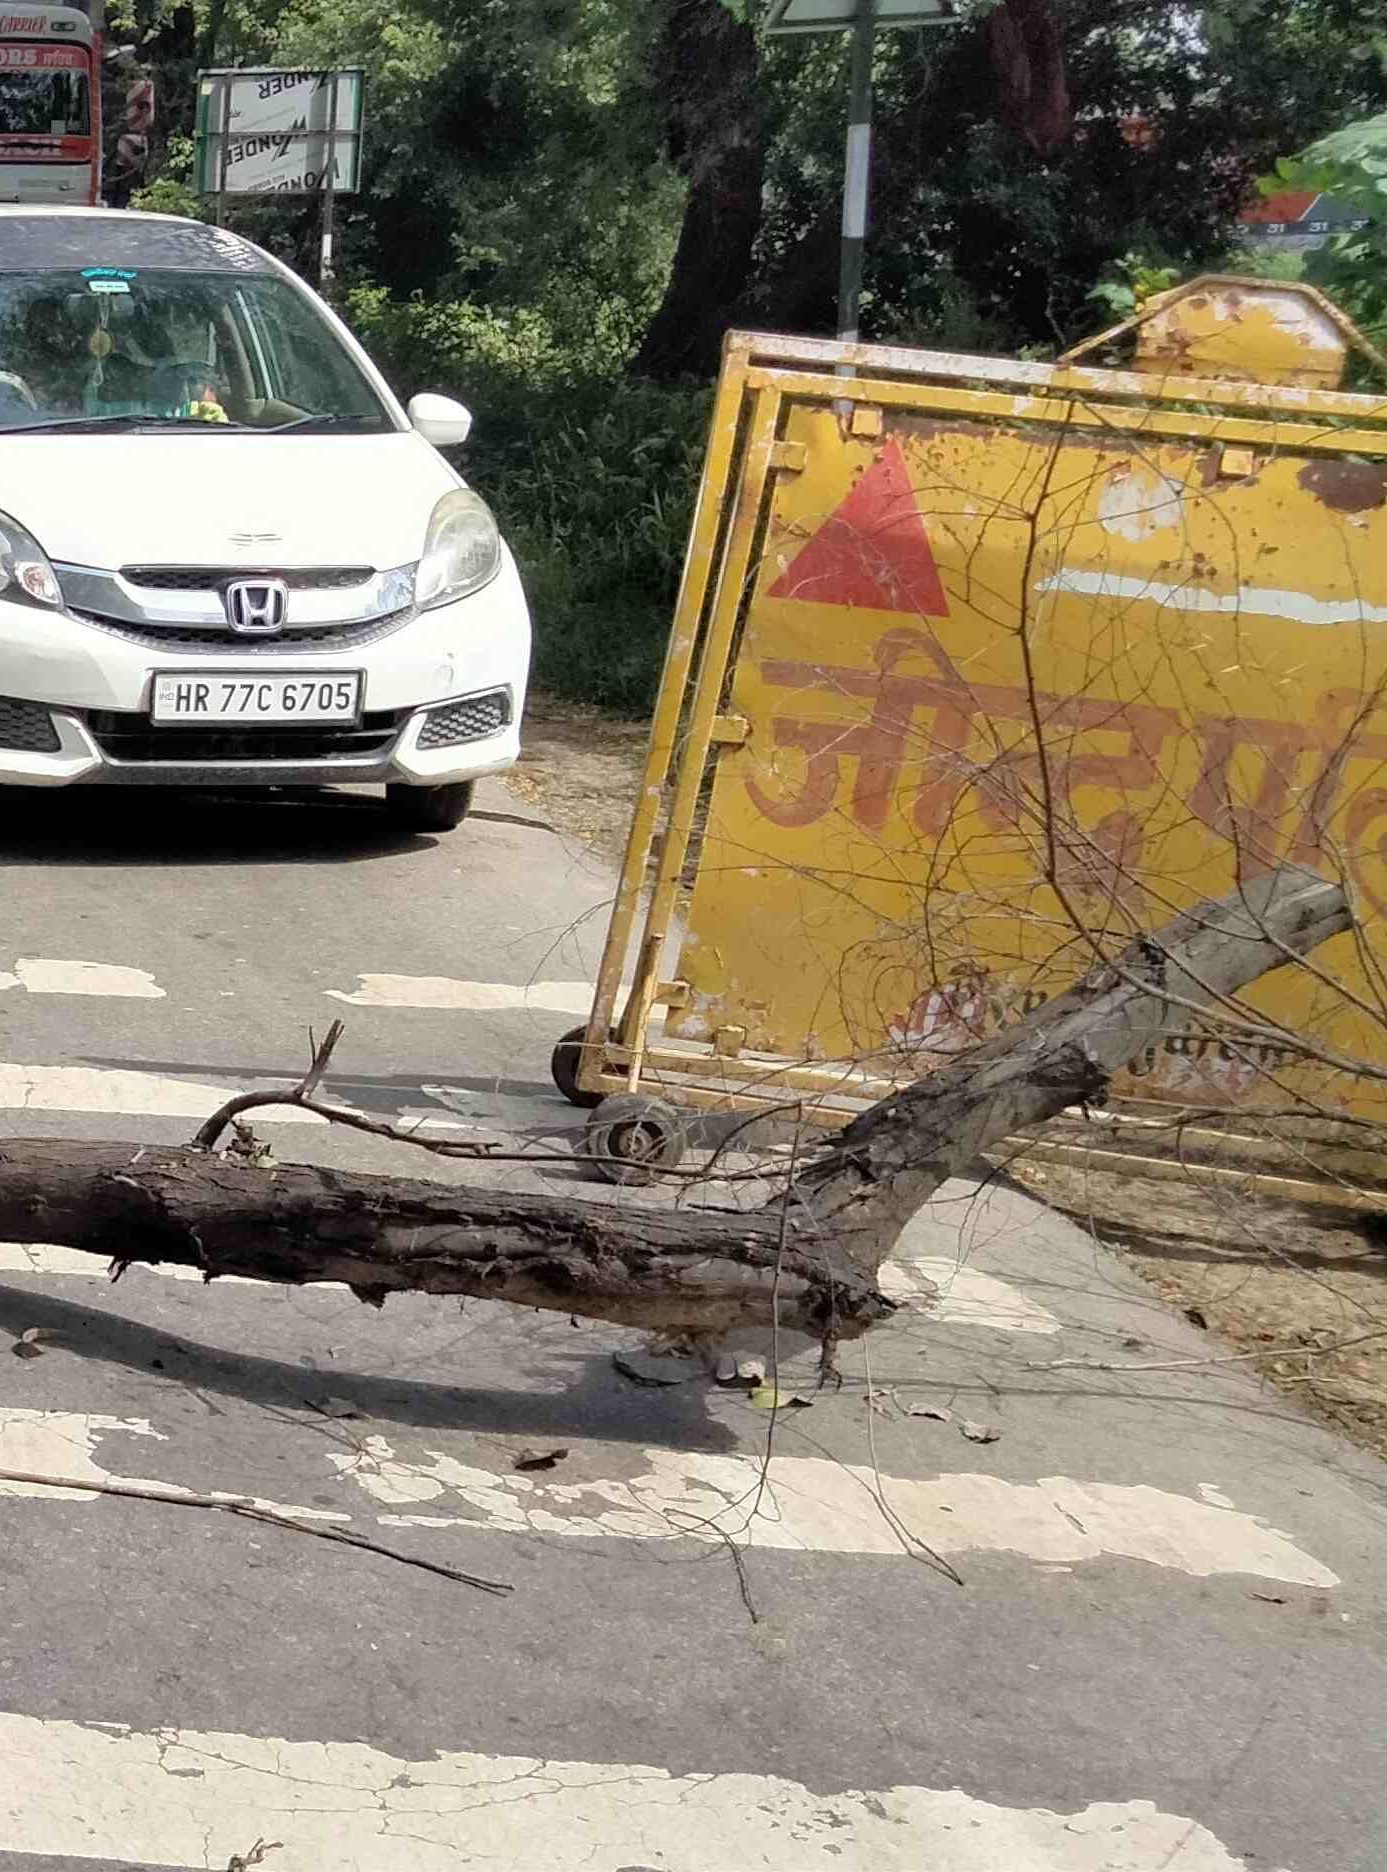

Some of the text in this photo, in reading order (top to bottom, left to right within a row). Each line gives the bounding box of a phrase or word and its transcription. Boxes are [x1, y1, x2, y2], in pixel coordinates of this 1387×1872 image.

[175, 683, 351, 713] HR 77C 6705
